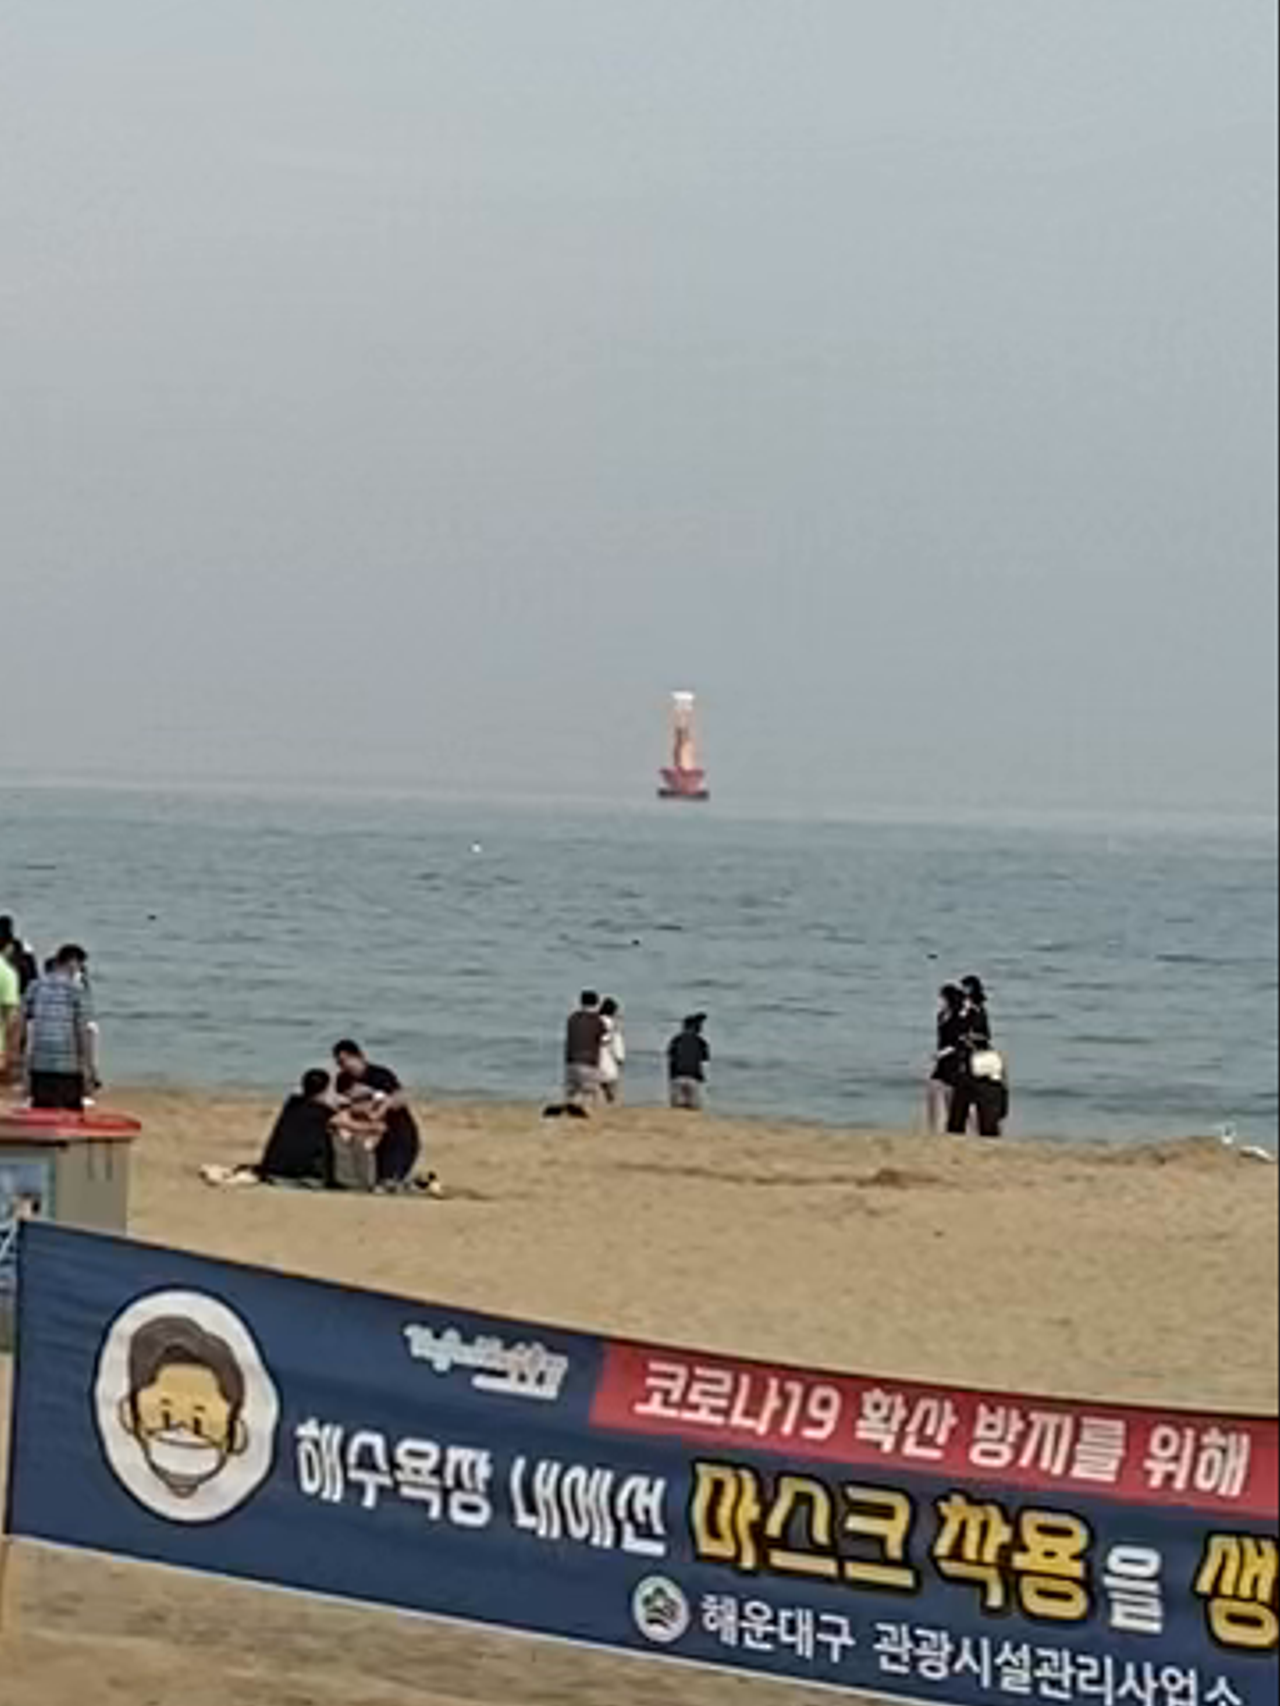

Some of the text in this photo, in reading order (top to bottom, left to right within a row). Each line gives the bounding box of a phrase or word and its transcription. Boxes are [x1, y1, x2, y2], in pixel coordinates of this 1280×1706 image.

[633, 1361, 841, 1440] 코로나19
[855, 1387, 958, 1459] 확산
[969, 1404, 1128, 1482] 방지를
[1143, 1427, 1251, 1497] 위해
[295, 1419, 491, 1526] 해수욕장
[509, 1456, 667, 1556] 내에선
[692, 1462, 916, 1589] 마스크
[932, 1494, 1164, 1635] 착용을
[699, 1594, 856, 1661] 해운대구
